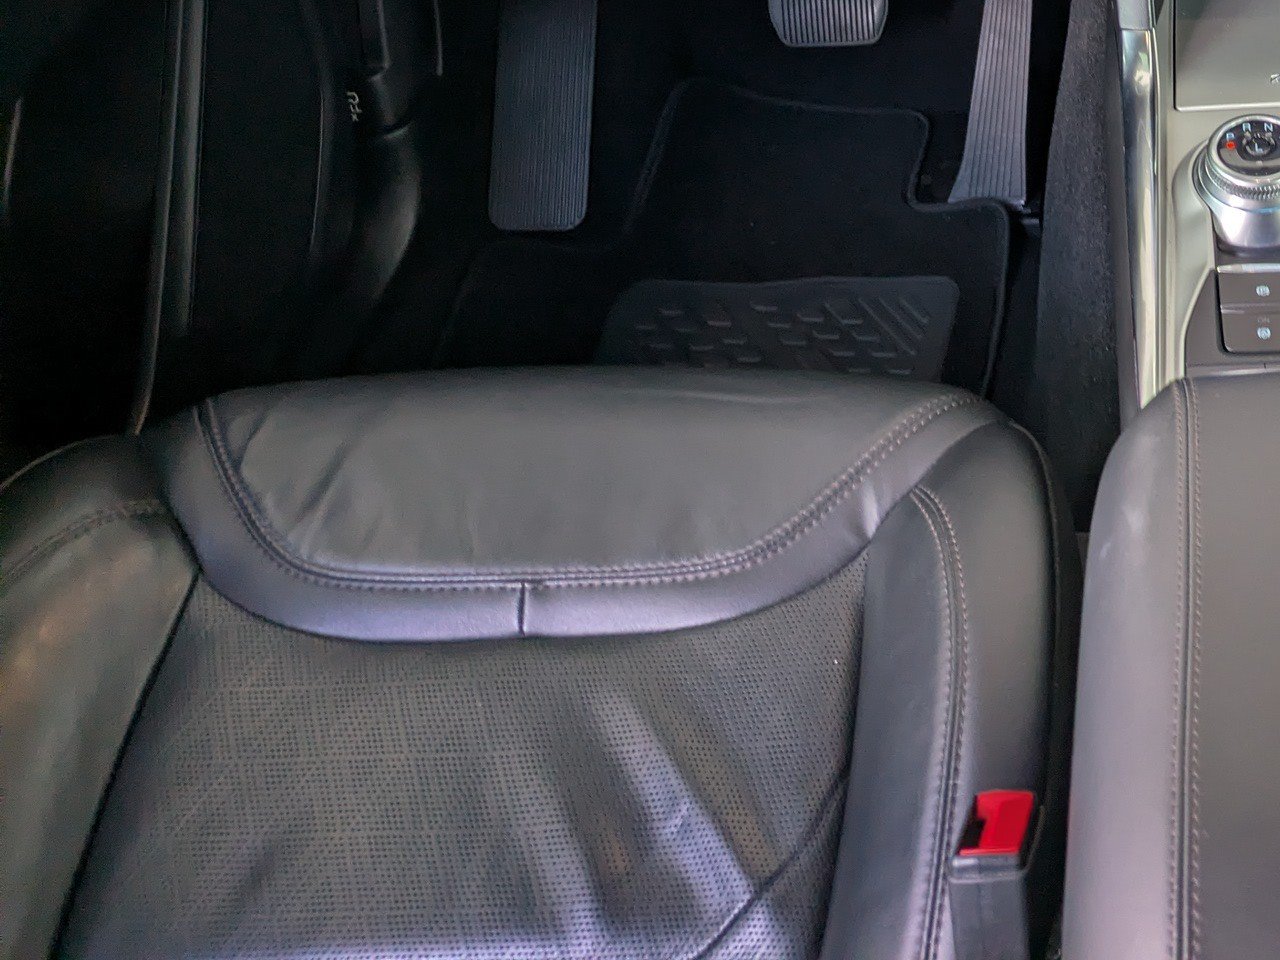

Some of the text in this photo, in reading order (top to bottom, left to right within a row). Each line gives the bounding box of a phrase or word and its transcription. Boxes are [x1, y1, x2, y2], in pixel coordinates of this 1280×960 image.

[1242, 122, 1252, 132] R
[1264, 122, 1274, 132] N
[1226, 131, 1235, 141] P
